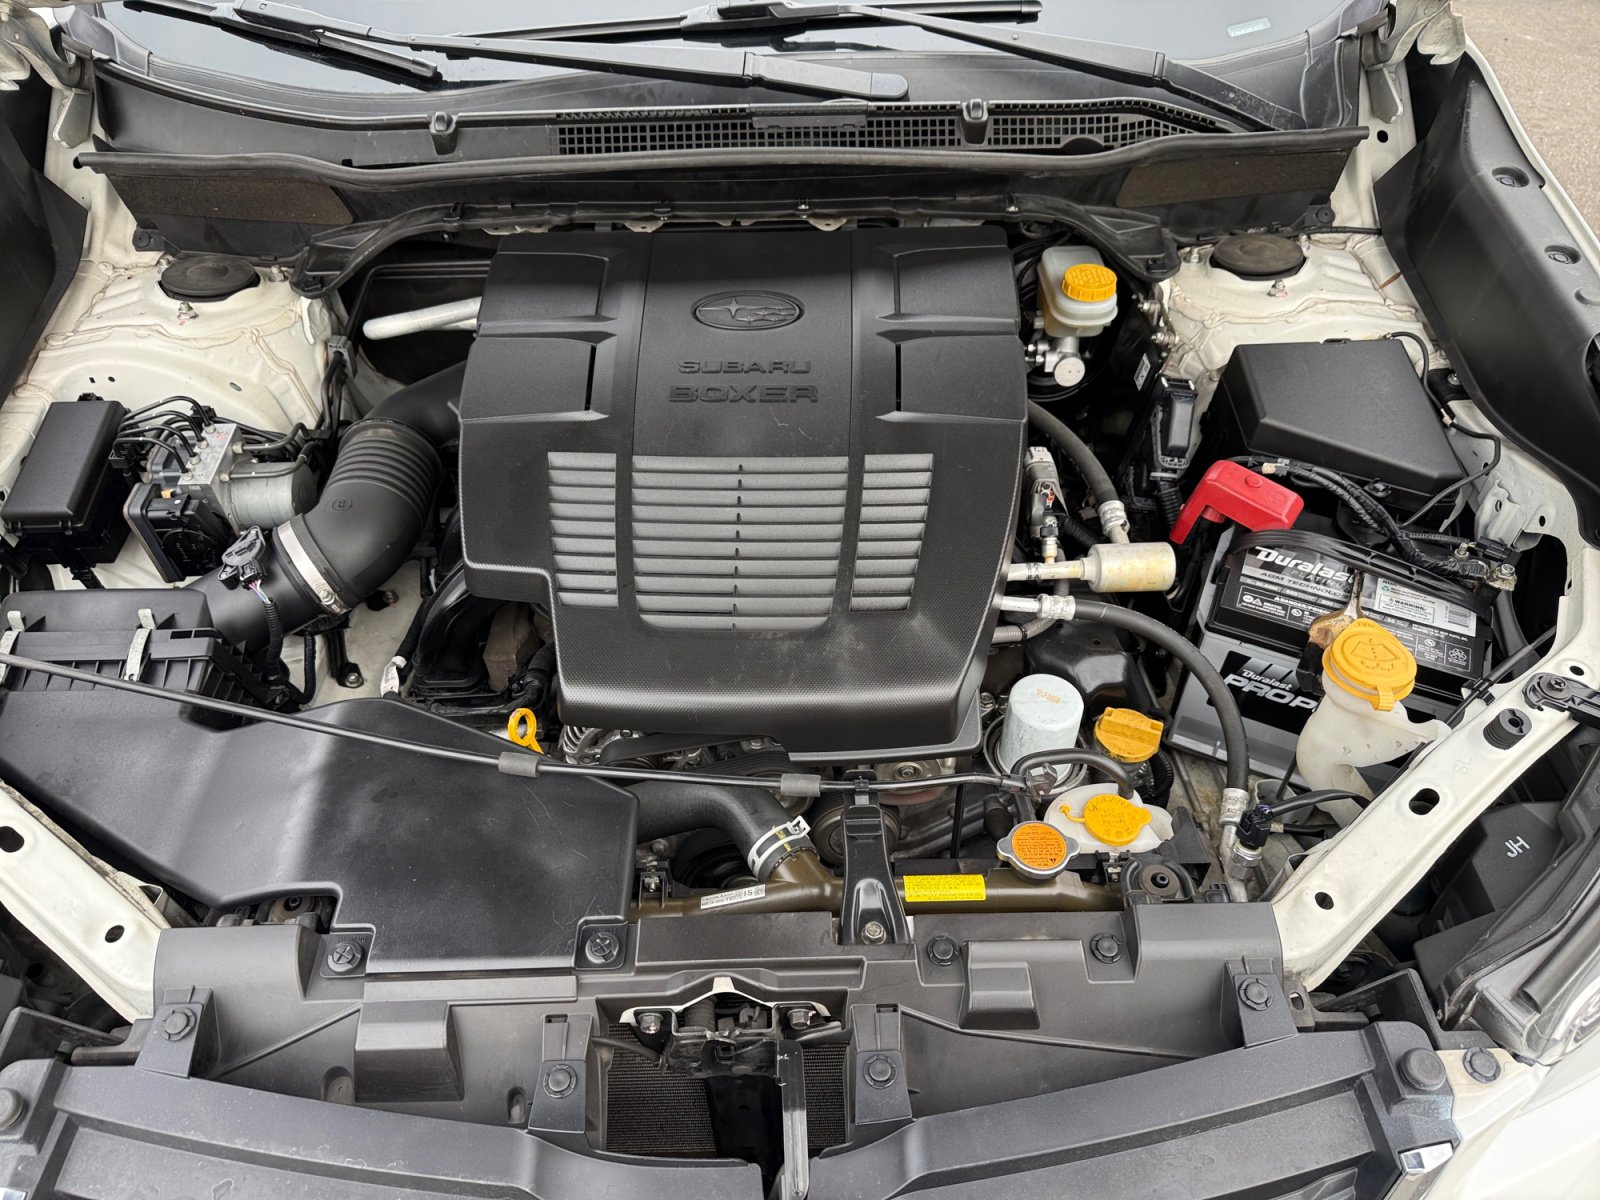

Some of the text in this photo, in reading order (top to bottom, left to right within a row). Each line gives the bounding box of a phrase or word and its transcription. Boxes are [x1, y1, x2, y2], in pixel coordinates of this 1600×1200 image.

[678, 359, 812, 374] SUBARU
[668, 384, 819, 403] BOXER
[1260, 571, 1285, 581] AGM
[1286, 578, 1351, 600] TECHNOLOG
[1242, 668, 1294, 691] Duralast
[1223, 673, 1318, 713] PROP
[1504, 835, 1531, 858] JH
